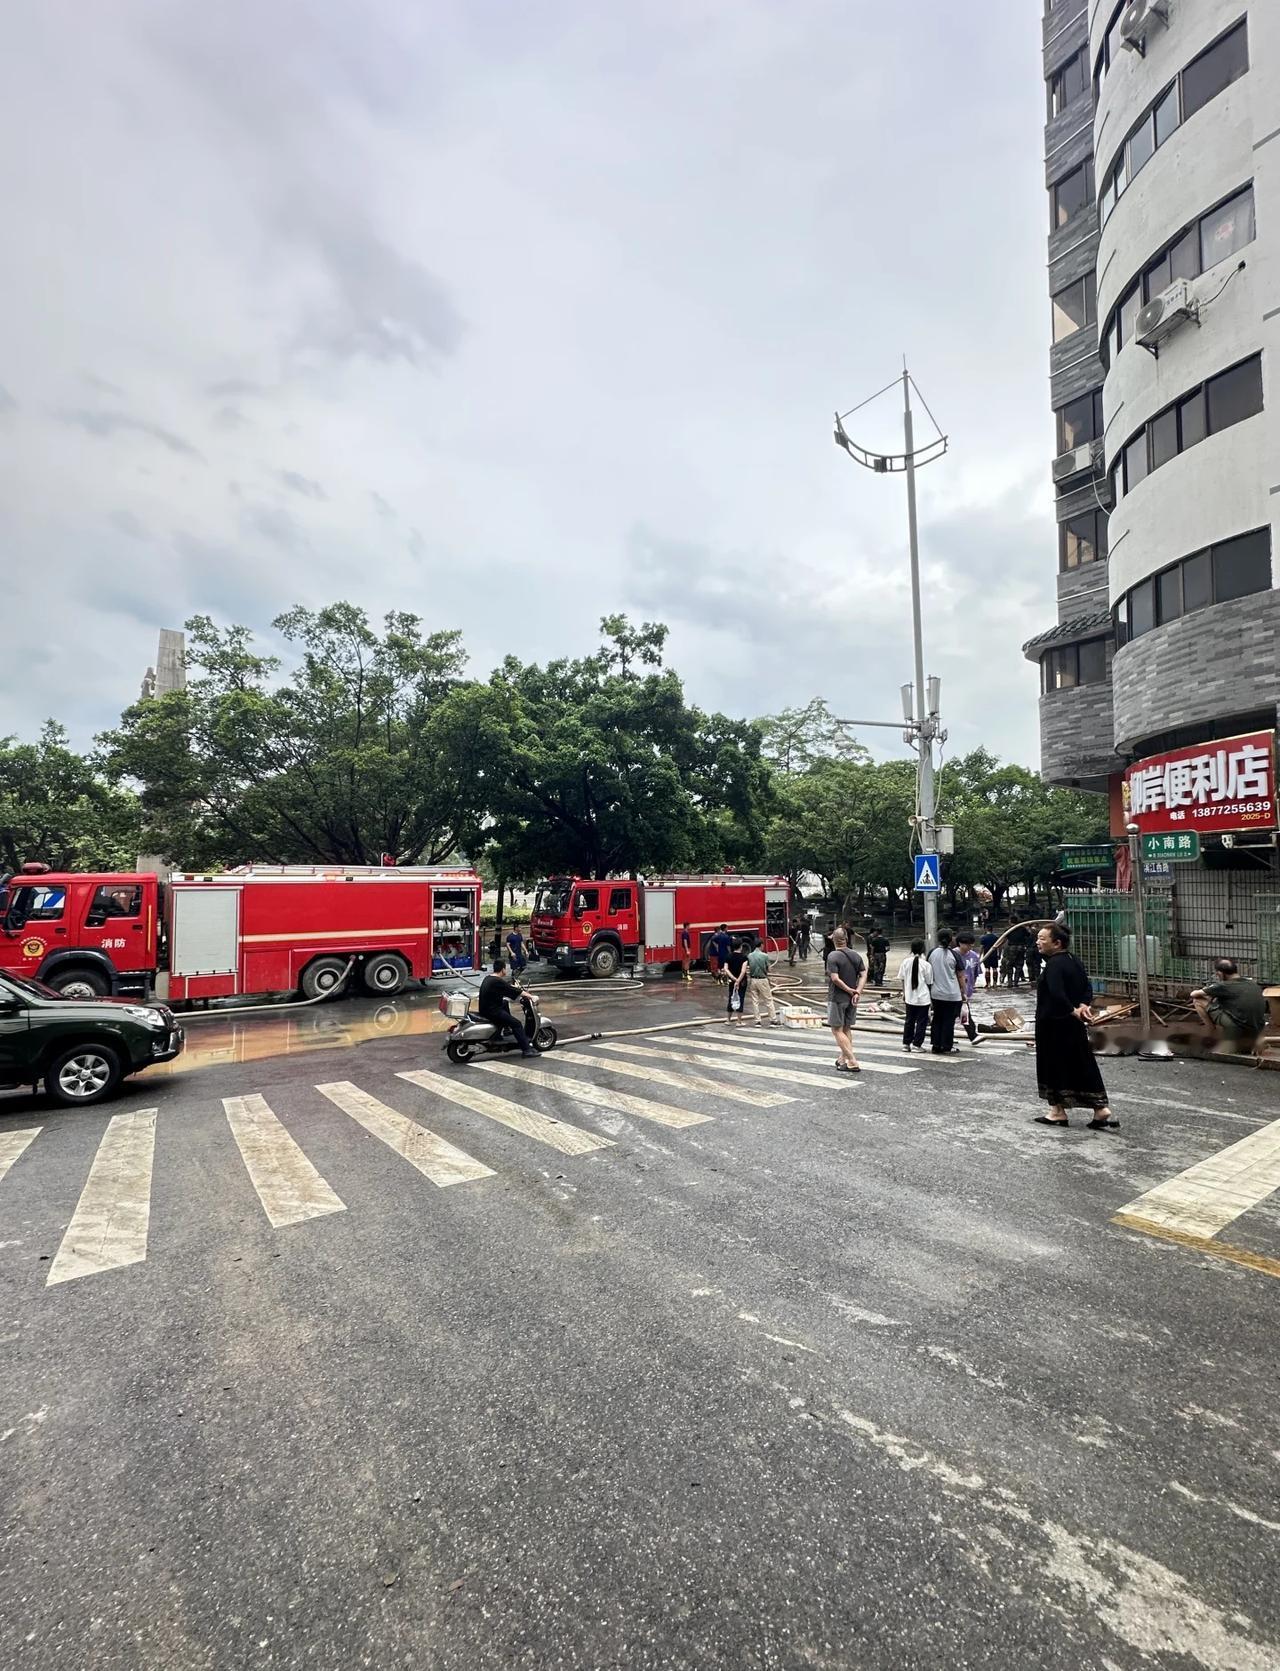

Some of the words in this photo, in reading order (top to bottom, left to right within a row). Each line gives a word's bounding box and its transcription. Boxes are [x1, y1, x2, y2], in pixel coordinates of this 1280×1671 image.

[1170, 810, 1186, 821] 电话
[1192, 801, 1271, 818] 13877255639
[1241, 812, 1271, 821] 2025-D
[1148, 835, 1191, 850] 小南路
[101, 937, 126, 949] 消防
